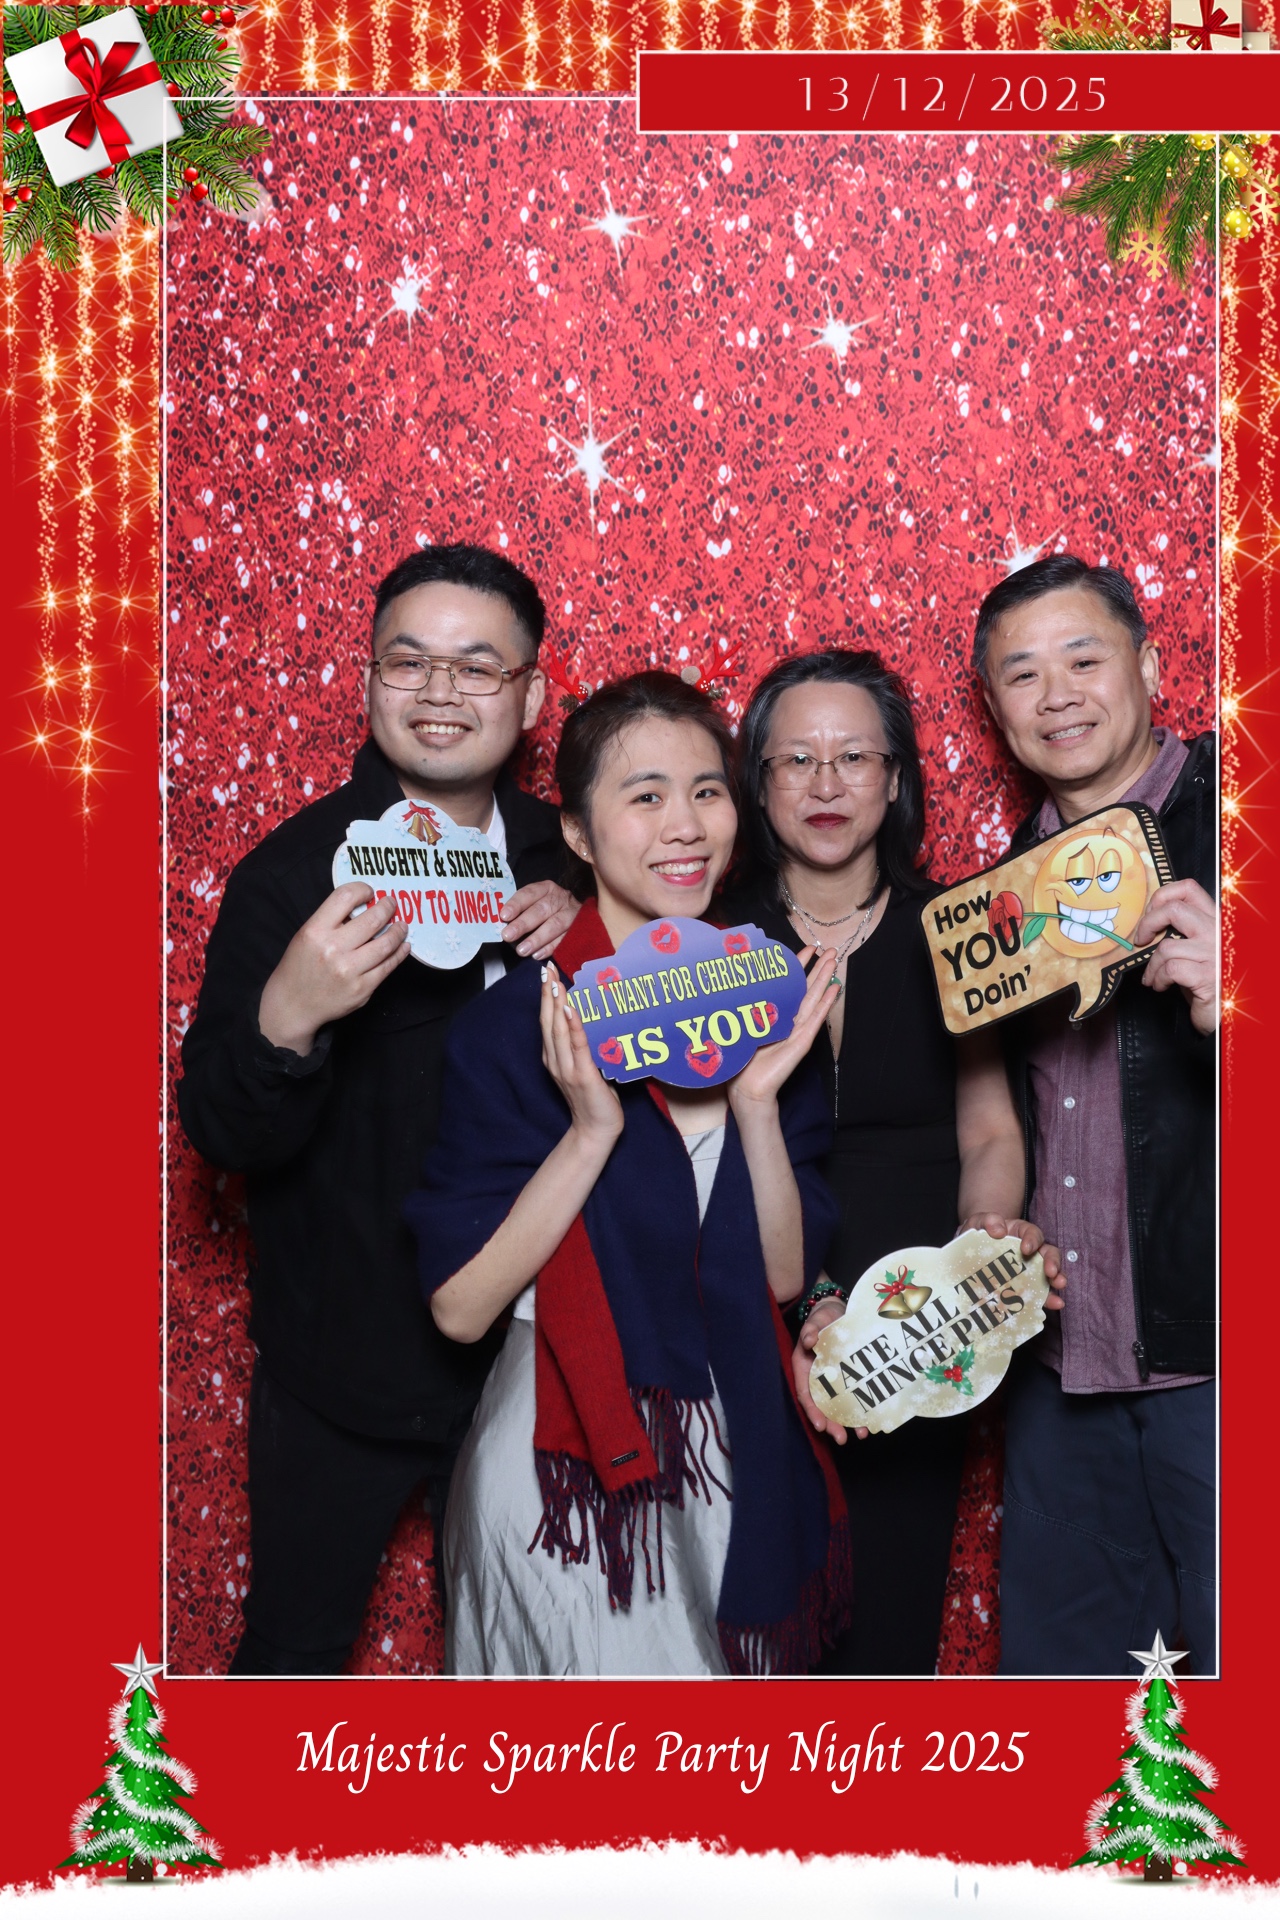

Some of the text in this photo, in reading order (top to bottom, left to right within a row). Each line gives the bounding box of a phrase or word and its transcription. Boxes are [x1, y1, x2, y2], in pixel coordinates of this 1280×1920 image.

[347, 846, 503, 878] NAUGHTY & SINGLE
[366, 889, 504, 924] ADY TO JINGLE
[934, 890, 991, 934] How
[597, 984, 612, 1018] I
[608, 974, 659, 1015] WANT
[657, 966, 697, 1004] FOR
[696, 944, 788, 995] CHRISTMAS
[941, 916, 1021, 981] YOU
[617, 1001, 772, 1071] IS YOU
[816, 1248, 1028, 1400] I ATE ALL THE
[850, 1286, 1025, 1414] MINCE PIES
